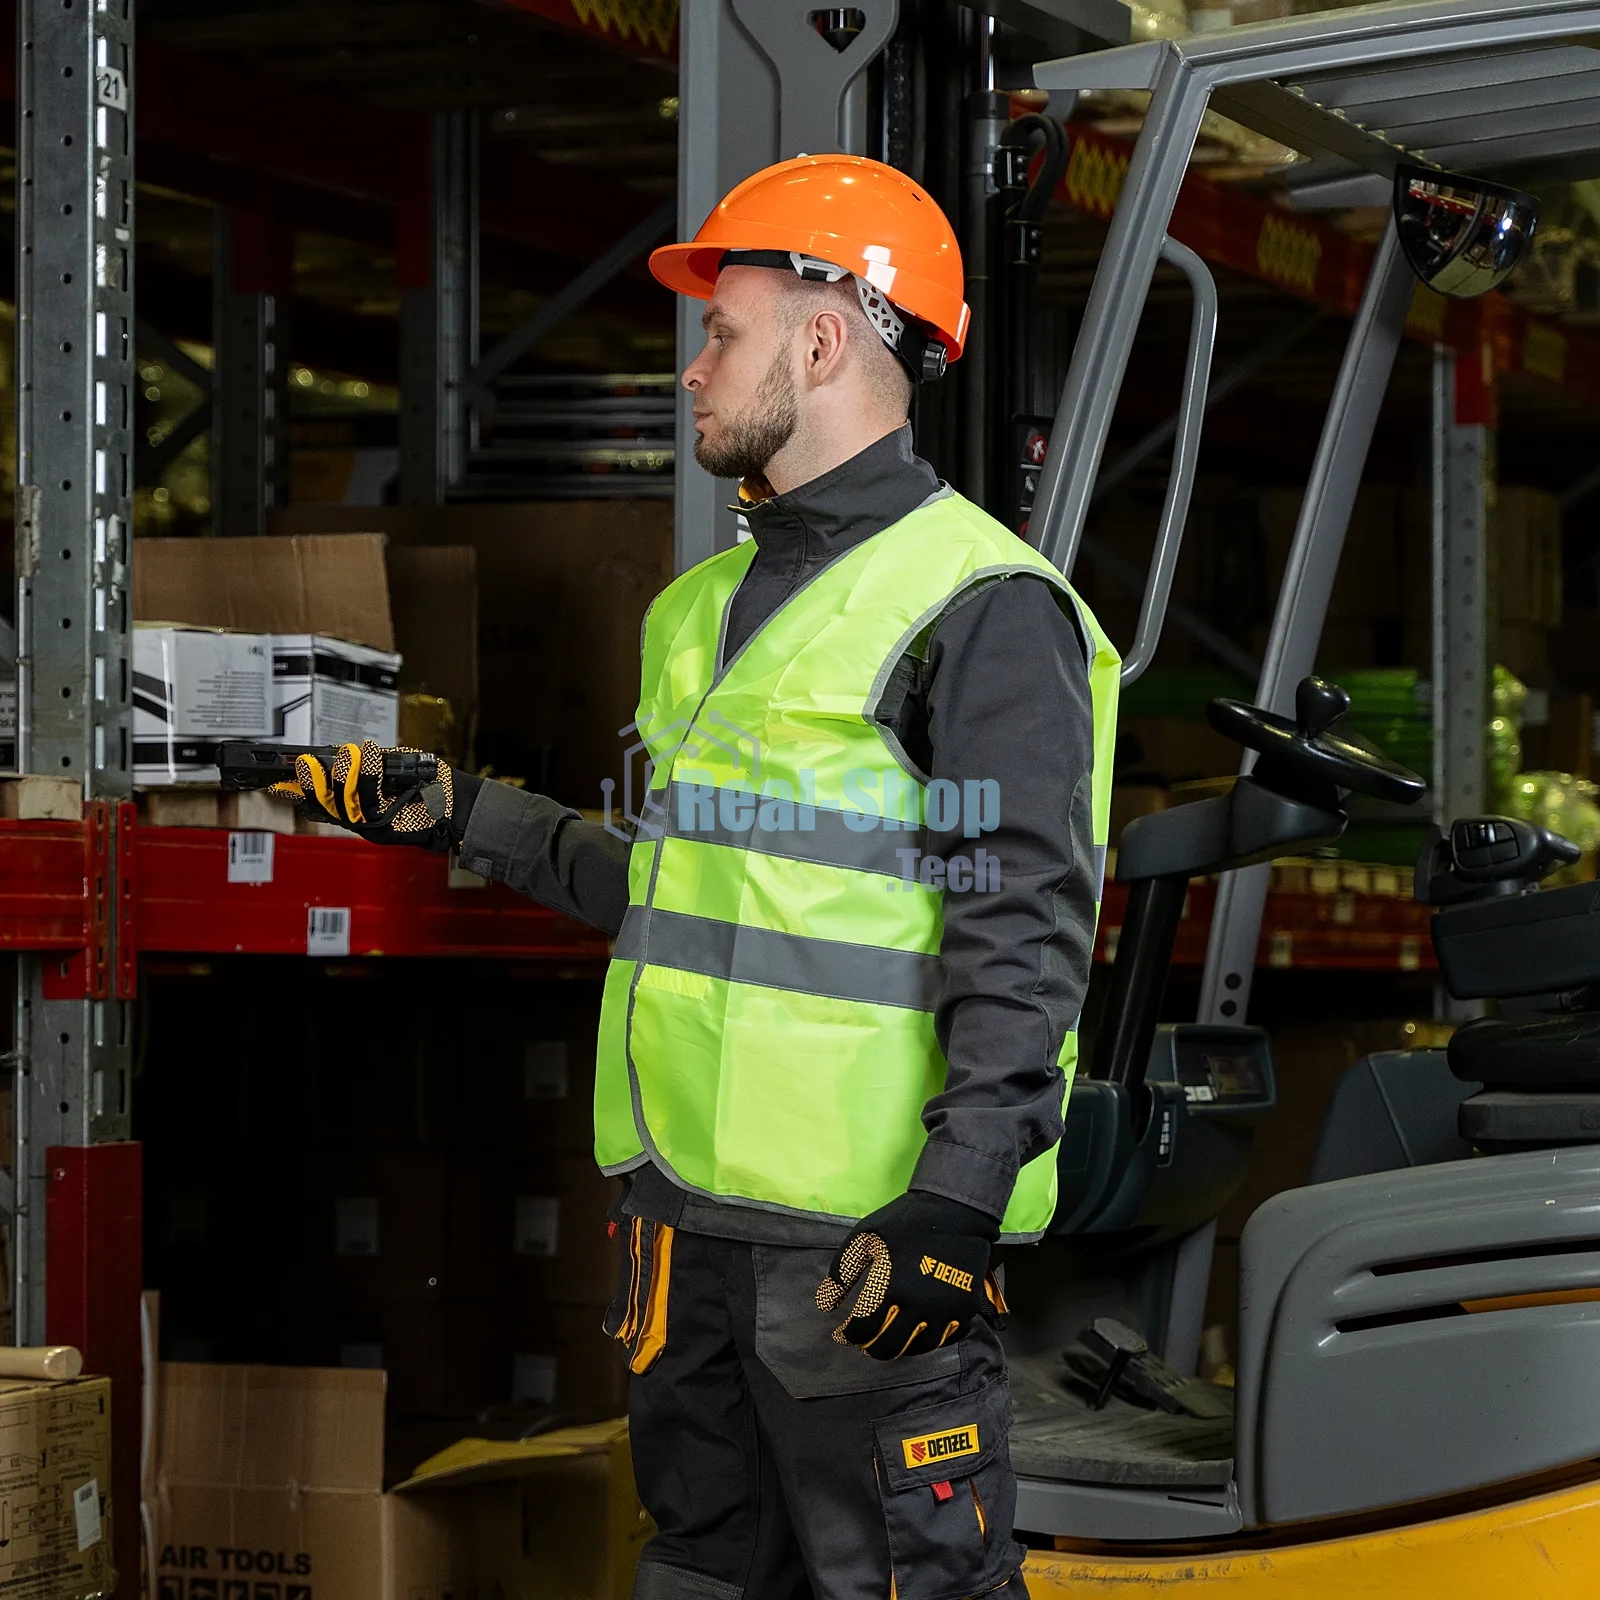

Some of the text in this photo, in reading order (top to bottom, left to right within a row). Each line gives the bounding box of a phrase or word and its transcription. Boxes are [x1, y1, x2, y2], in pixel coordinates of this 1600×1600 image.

[101, 73, 119, 100] 21
[933, 1261, 974, 1292] DENZEL
[927, 1431, 973, 1458] DENZEL
[159, 1544, 312, 1575] AIR TOOLS
